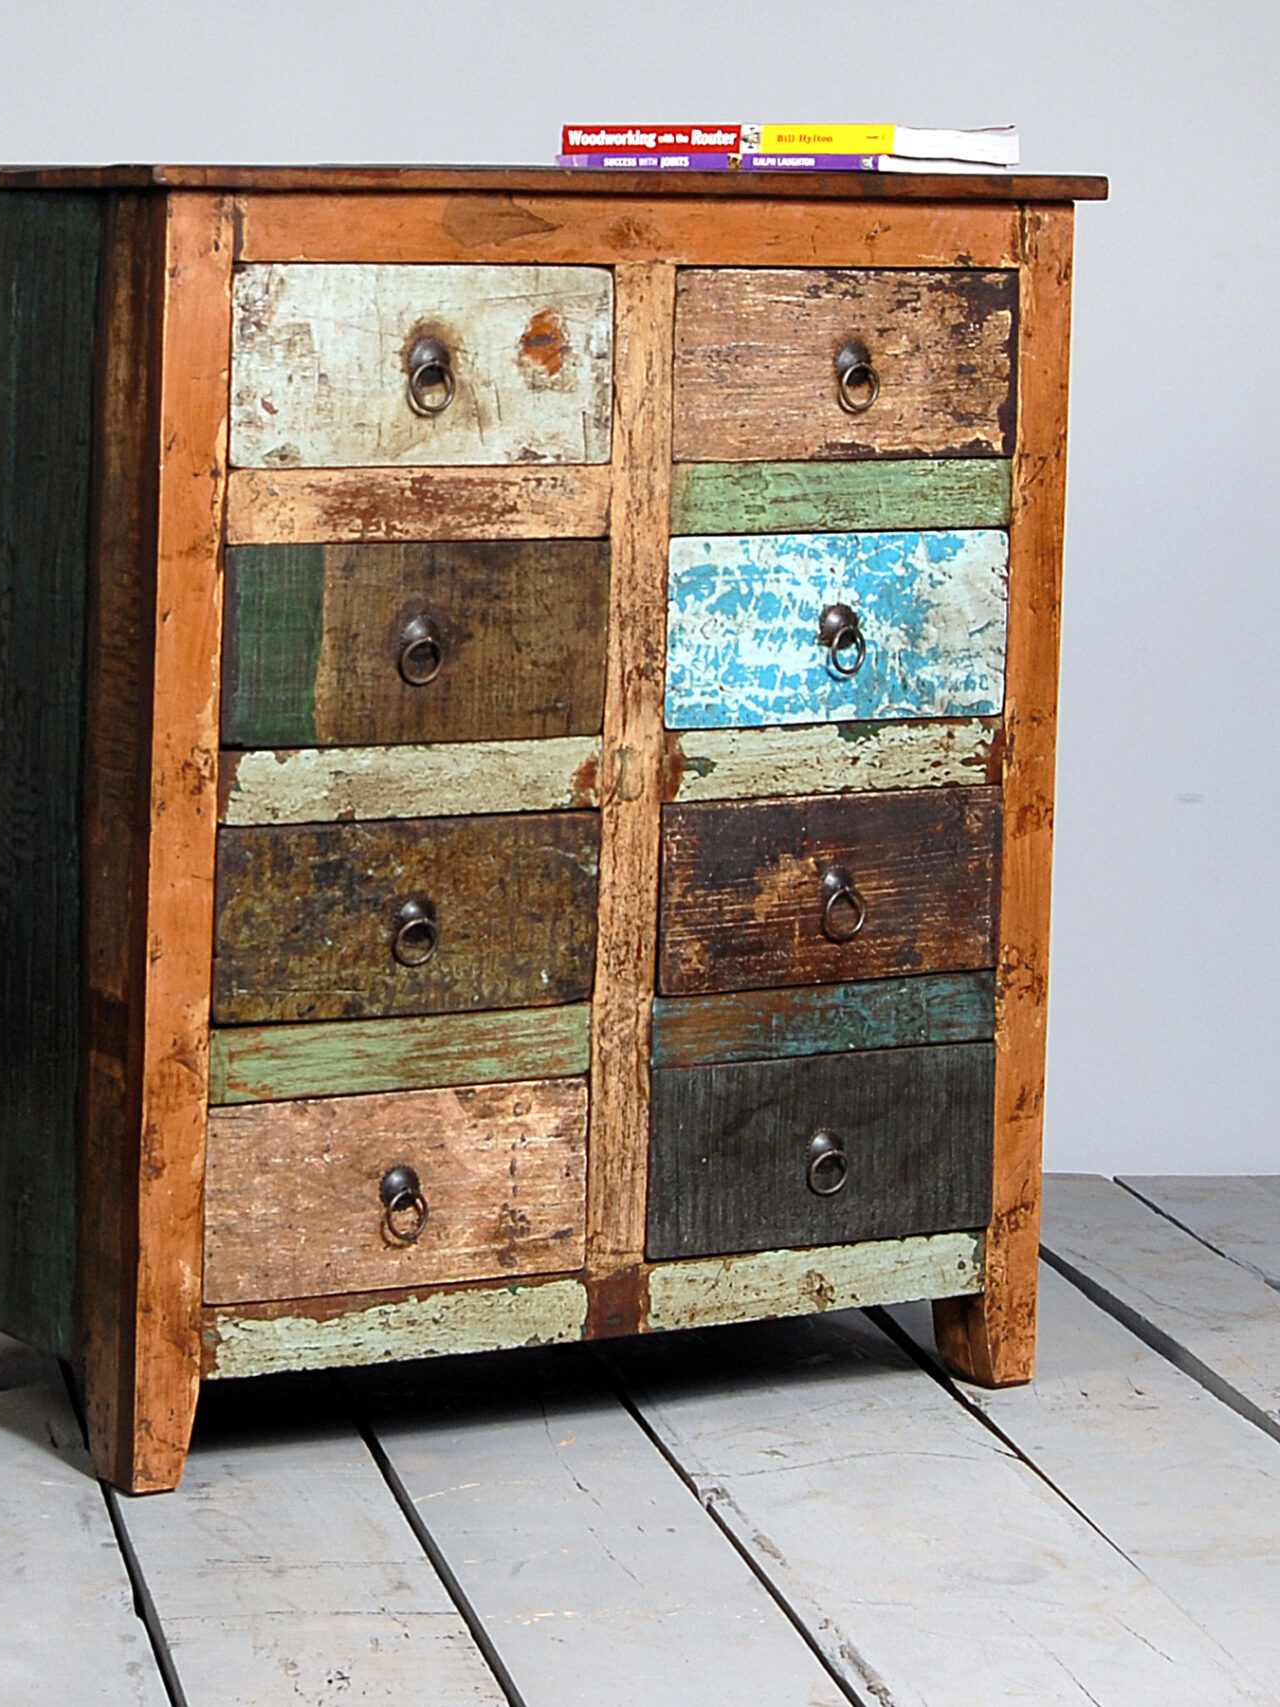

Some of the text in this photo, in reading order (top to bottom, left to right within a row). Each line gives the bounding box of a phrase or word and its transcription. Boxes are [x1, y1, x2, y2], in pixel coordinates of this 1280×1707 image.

[568, 129, 657, 148] Woodworking
[675, 133, 689, 144] the
[691, 129, 738, 146] Router
[777, 134, 833, 145] Bill Hylton
[638, 157, 658, 167] WITH
[752, 157, 776, 166] RALPH
